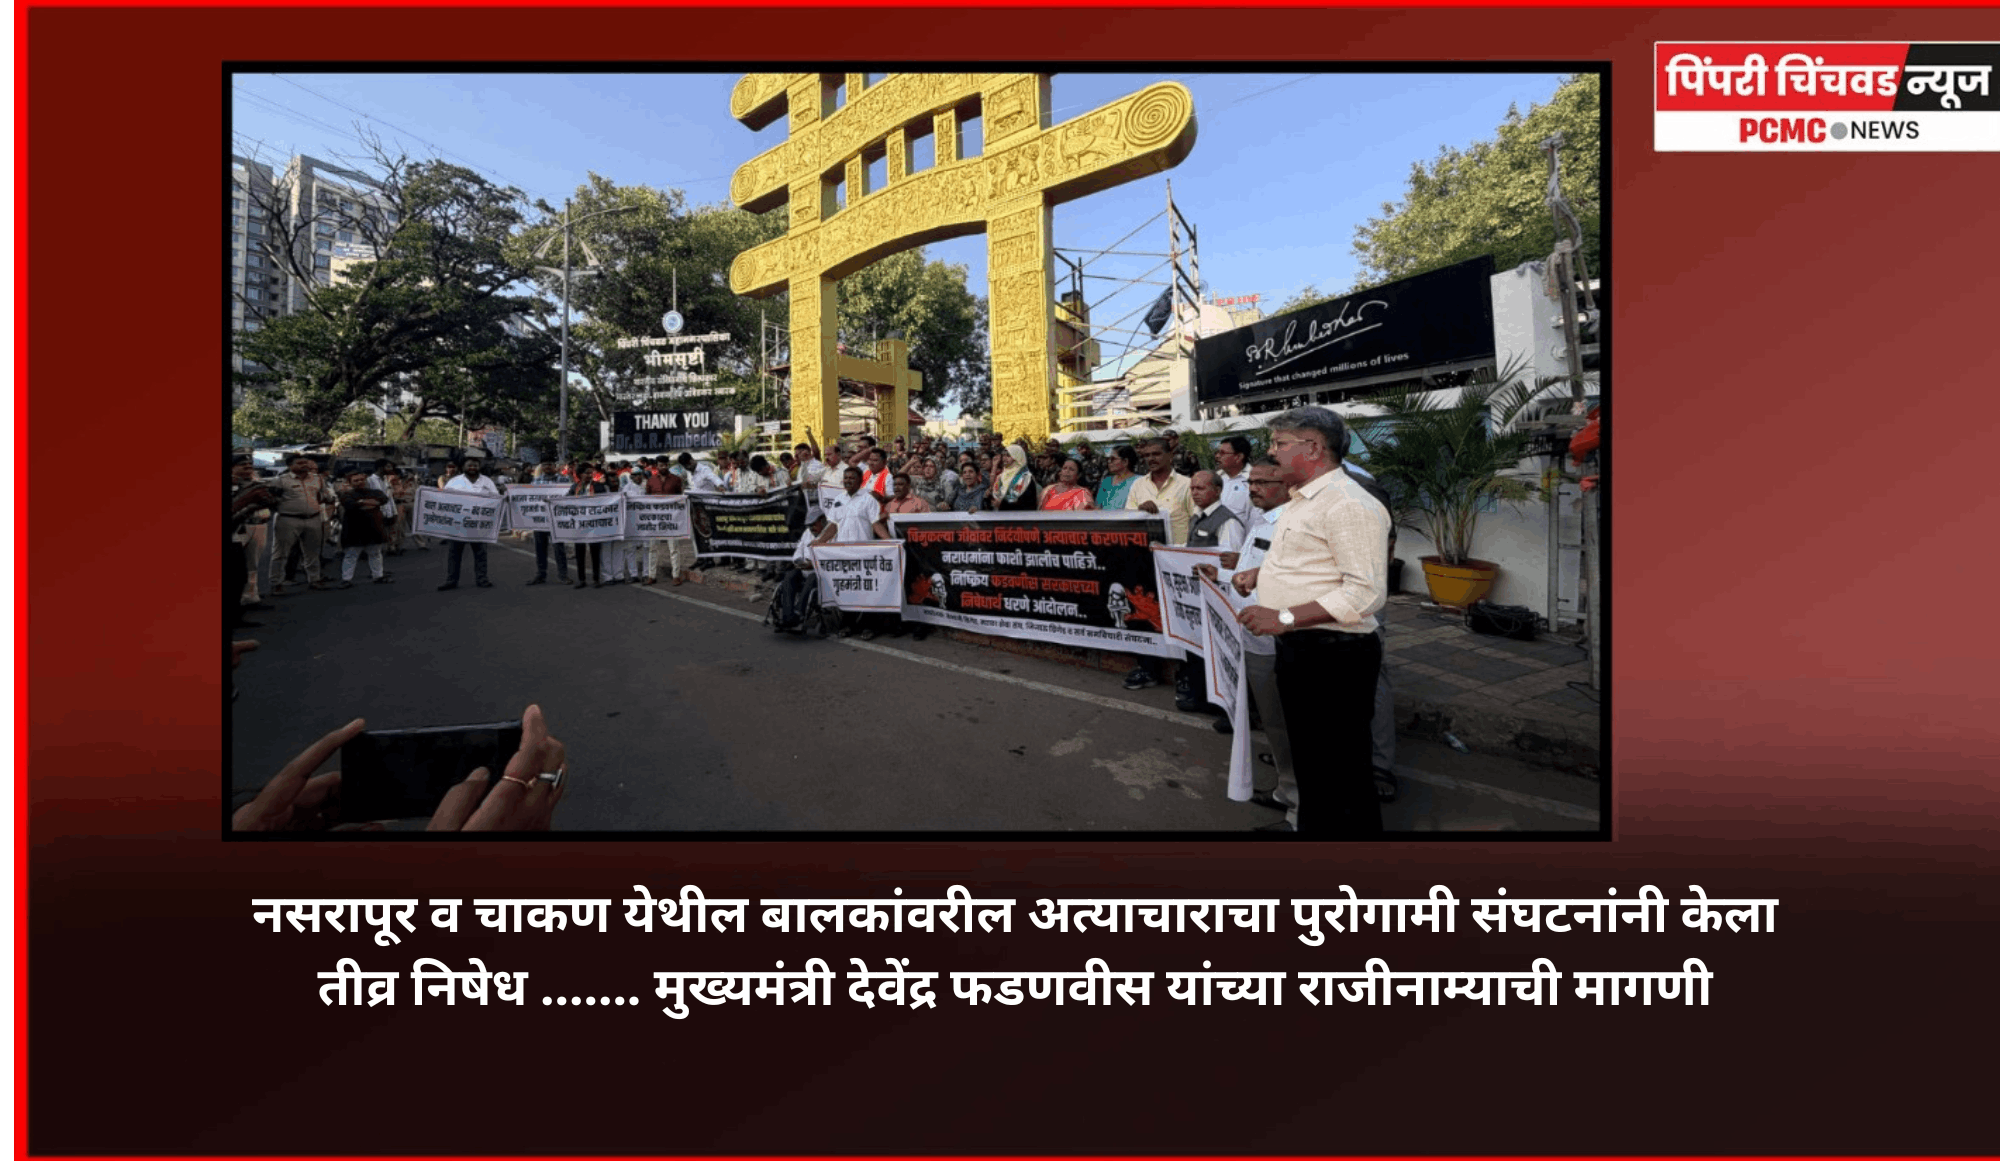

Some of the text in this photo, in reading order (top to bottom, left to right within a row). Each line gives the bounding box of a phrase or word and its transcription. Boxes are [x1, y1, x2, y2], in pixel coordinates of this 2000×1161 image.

[643, 347, 704, 370] भीमसृष्टी
[1239, 353, 1410, 390] Signature that changed millions of lives
[635, 412, 709, 430] THANK YOU
[908, 527, 955, 546] चिमुकल्या
[995, 526, 1040, 544] निर्दयीपणे
[1043, 530, 1088, 545] अत्याचार
[879, 555, 893, 572] वेळ
[942, 549, 994, 565] नराधमांना
[996, 549, 1023, 566] फाशी
[1025, 550, 1060, 567] झालीच
[950, 569, 989, 587] निष्क्रिय
[1041, 578, 1100, 596] सरकारच्या
[961, 592, 1002, 611] निषेधार्थ
[1003, 594, 1030, 612] धरणे
